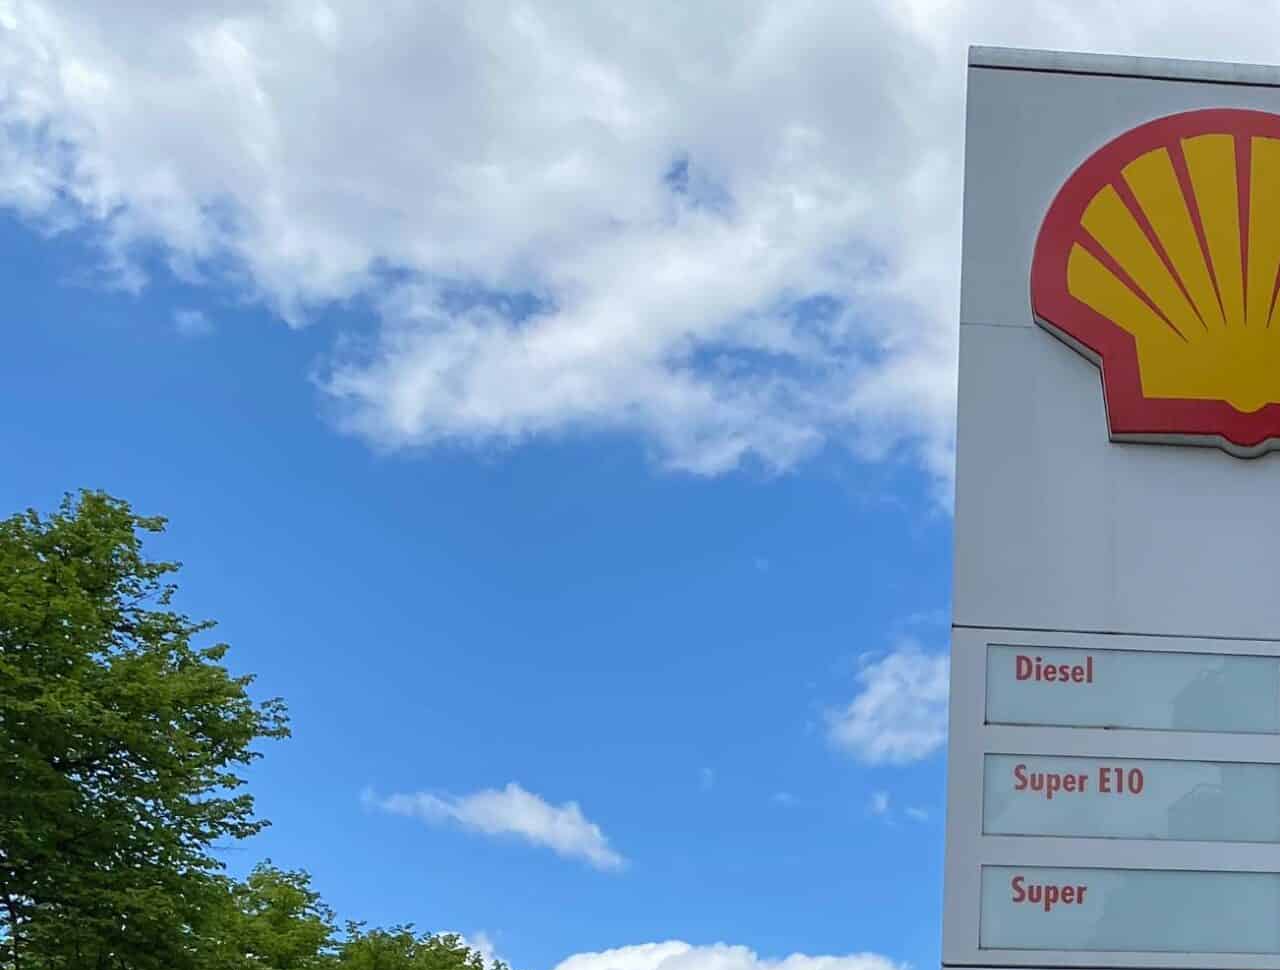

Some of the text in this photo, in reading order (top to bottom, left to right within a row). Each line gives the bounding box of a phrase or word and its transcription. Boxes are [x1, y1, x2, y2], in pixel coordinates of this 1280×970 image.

[1015, 655, 1093, 684] Diesel
[1013, 764, 1144, 798] Super E10
[1011, 876, 1087, 910] Super
